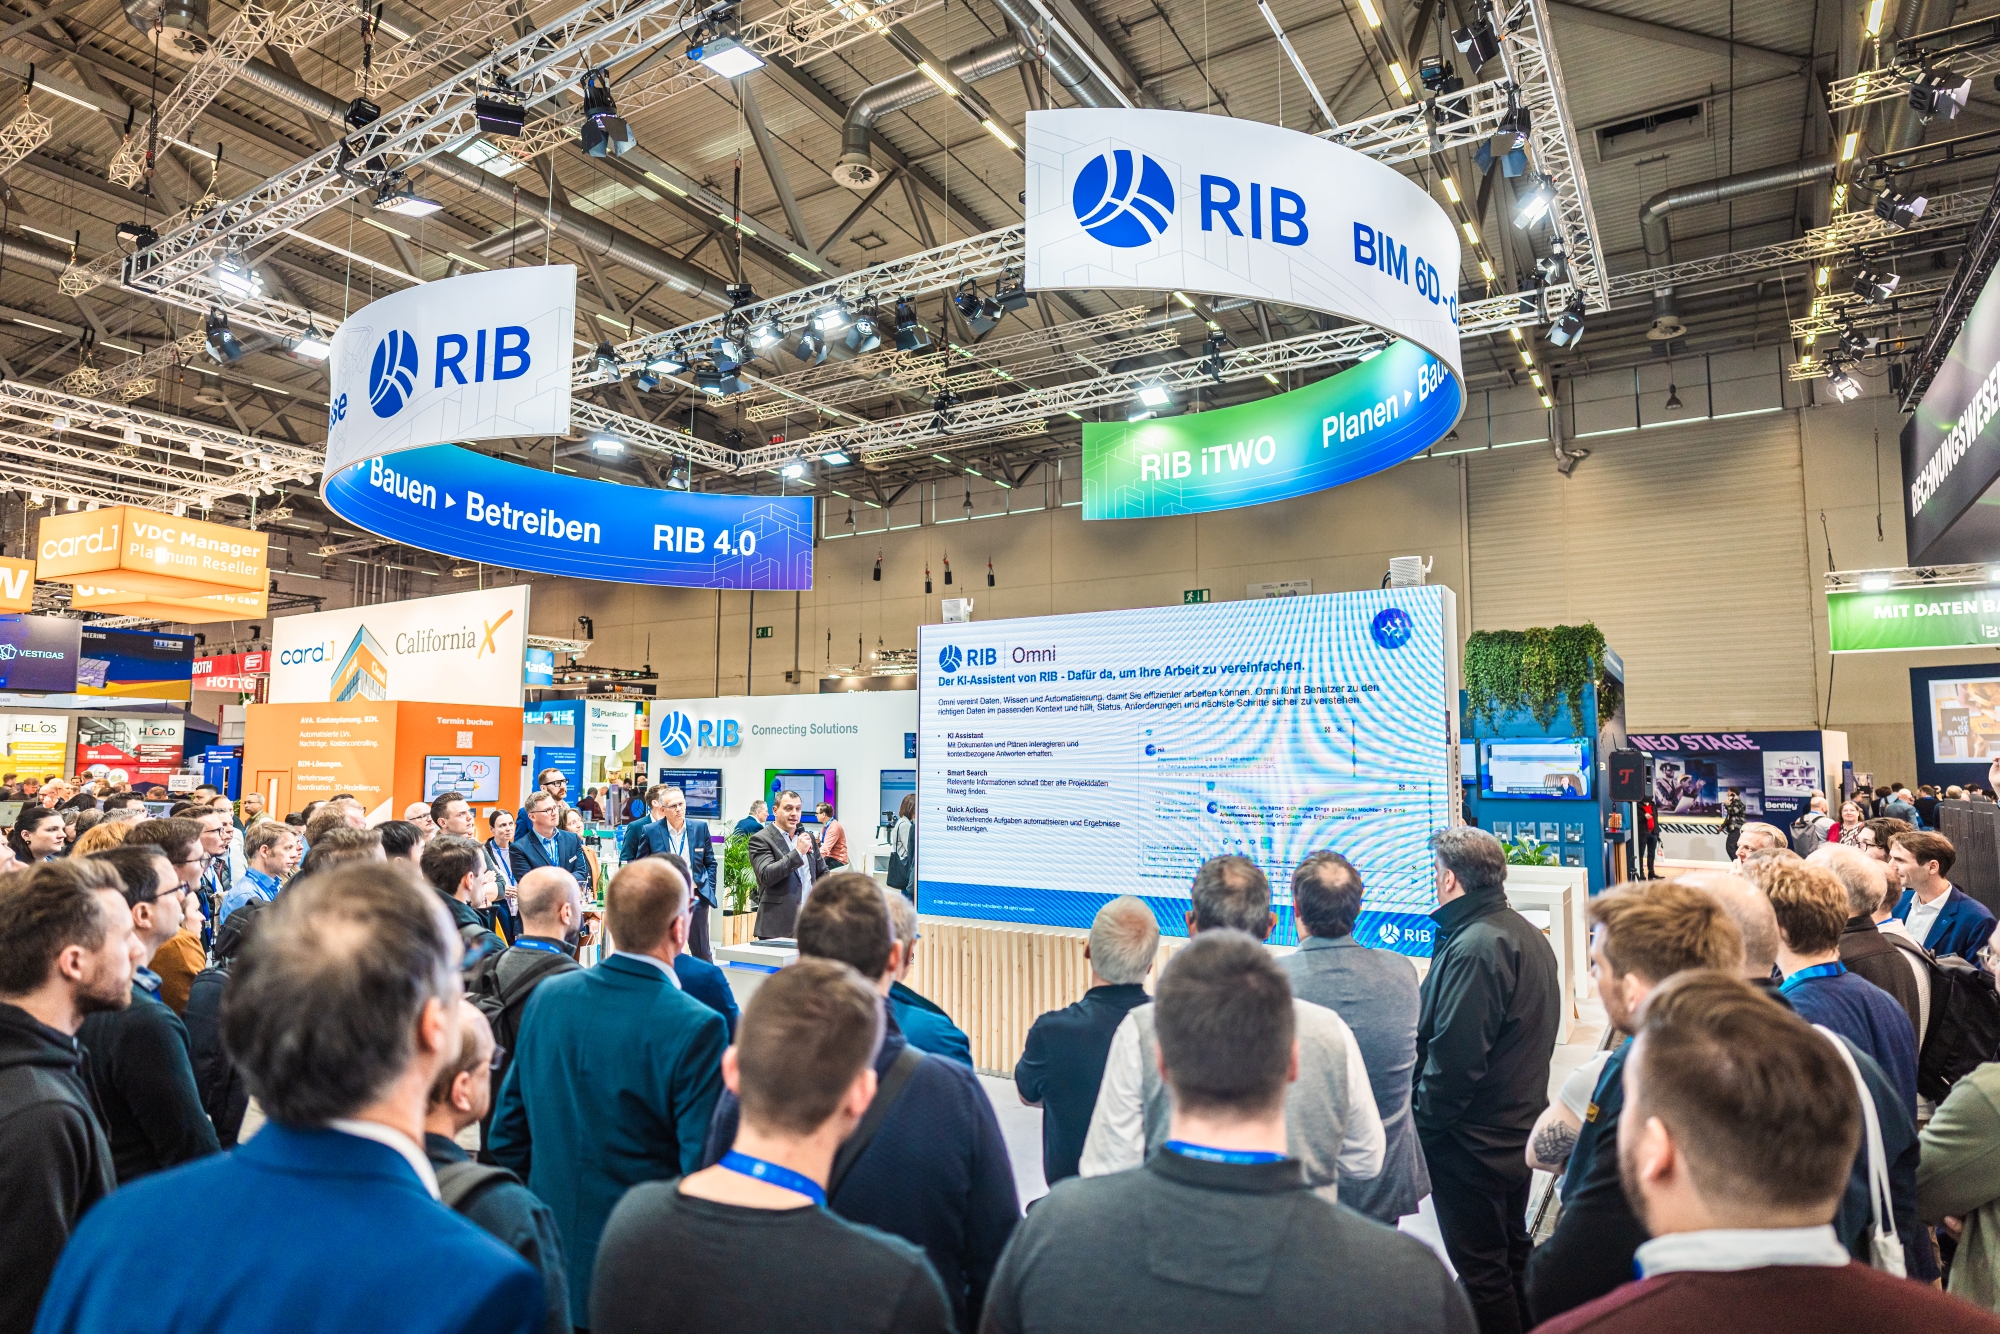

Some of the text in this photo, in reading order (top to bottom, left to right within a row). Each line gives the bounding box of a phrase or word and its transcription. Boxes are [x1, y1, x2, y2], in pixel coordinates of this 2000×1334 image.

[1200, 174, 1309, 246] RIB
[1353, 222, 1408, 285] BIM
[434, 325, 531, 389] RIB
[1322, 394, 1399, 448] Planen
[1140, 434, 1276, 482] RIB iTWO
[370, 455, 600, 544] Bauen Betreiben
[132, 522, 260, 558] VDC Manager
[653, 525, 756, 556] RIB 4.0
[130, 542, 258, 576] Planum Reseller
[224, 594, 236, 604] by
[1874, 604, 1910, 620] MIT
[1914, 600, 1978, 617] DATEN
[82, 632, 107, 640] NEERING
[396, 626, 476, 656] California
[19, 650, 64, 660] VESTIGAS
[967, 645, 1056, 666] RIB Omni
[192, 660, 213, 675] ROTH
[938, 660, 1305, 686] Der KI-Assistent von RIB Dafür da, um Ihre Arbeit zu vereinfachen.
[938, 698, 955, 706] Omni
[956, 697, 979, 706] vereint
[980, 697, 1002, 706] Daten,
[1004, 696, 1030, 704] Wissen
[1045, 693, 1104, 703] Automatisierung,
[1107, 692, 1127, 700] damit
[1130, 692, 1141, 700] Sie
[1144, 691, 1182, 699] effizienter
[1184, 690, 1217, 698] arbeiten
[1219, 688, 1253, 697] können.
[1255, 687, 1279, 696] Omni
[1281, 686, 1302, 695] führt
[1304, 685, 1345, 694] Benutzer
[1361, 684, 1380, 692] den
[938, 707, 965, 716] richtigen
[966, 706, 985, 715] Daten
[987, 706, 996, 714] im
[997, 705, 1034, 715] passenden
[1036, 705, 1062, 713] Kontext
[1064, 704, 1078, 712] und
[1080, 704, 1094, 712] hilft,
[1097, 703, 1122, 711] Status,
[1124, 701, 1182, 711] Anforderungen
[1201, 699, 1234, 708] nächste
[1236, 698, 1270, 707] Schritte
[1272, 697, 1298, 706] sicher
[1301, 697, 1312, 705] zu
[1314, 696, 1362, 705] verstehen.
[300, 715, 379, 724] AVA. Kostenplanung. BIM.
[436, 716, 494, 726] Termin buchen
[600, 710, 629, 718] PlanRadar
[299, 730, 339, 738] Automatisierte
[698, 719, 740, 747] RIB
[752, 722, 859, 737] Connecting Solutions
[299, 740, 379, 748] Nachträge. Kostencontrolling.
[1029, 740, 1065, 750] interagieren
[1628, 734, 1760, 751] NEO STAGE
[1068, 780, 1109, 788] Projektdaten
[947, 788, 967, 796] hinweg
[947, 806, 964, 814] Quick
[1765, 801, 1798, 810] Bentley
[994, 817, 1023, 825] Aufgaben
[1024, 818, 1069, 826] automatisieren
[1084, 820, 1120, 828] Ergebnisse
[1658, 823, 1729, 834] RMATIO
[1404, 929, 1432, 942] RIB
